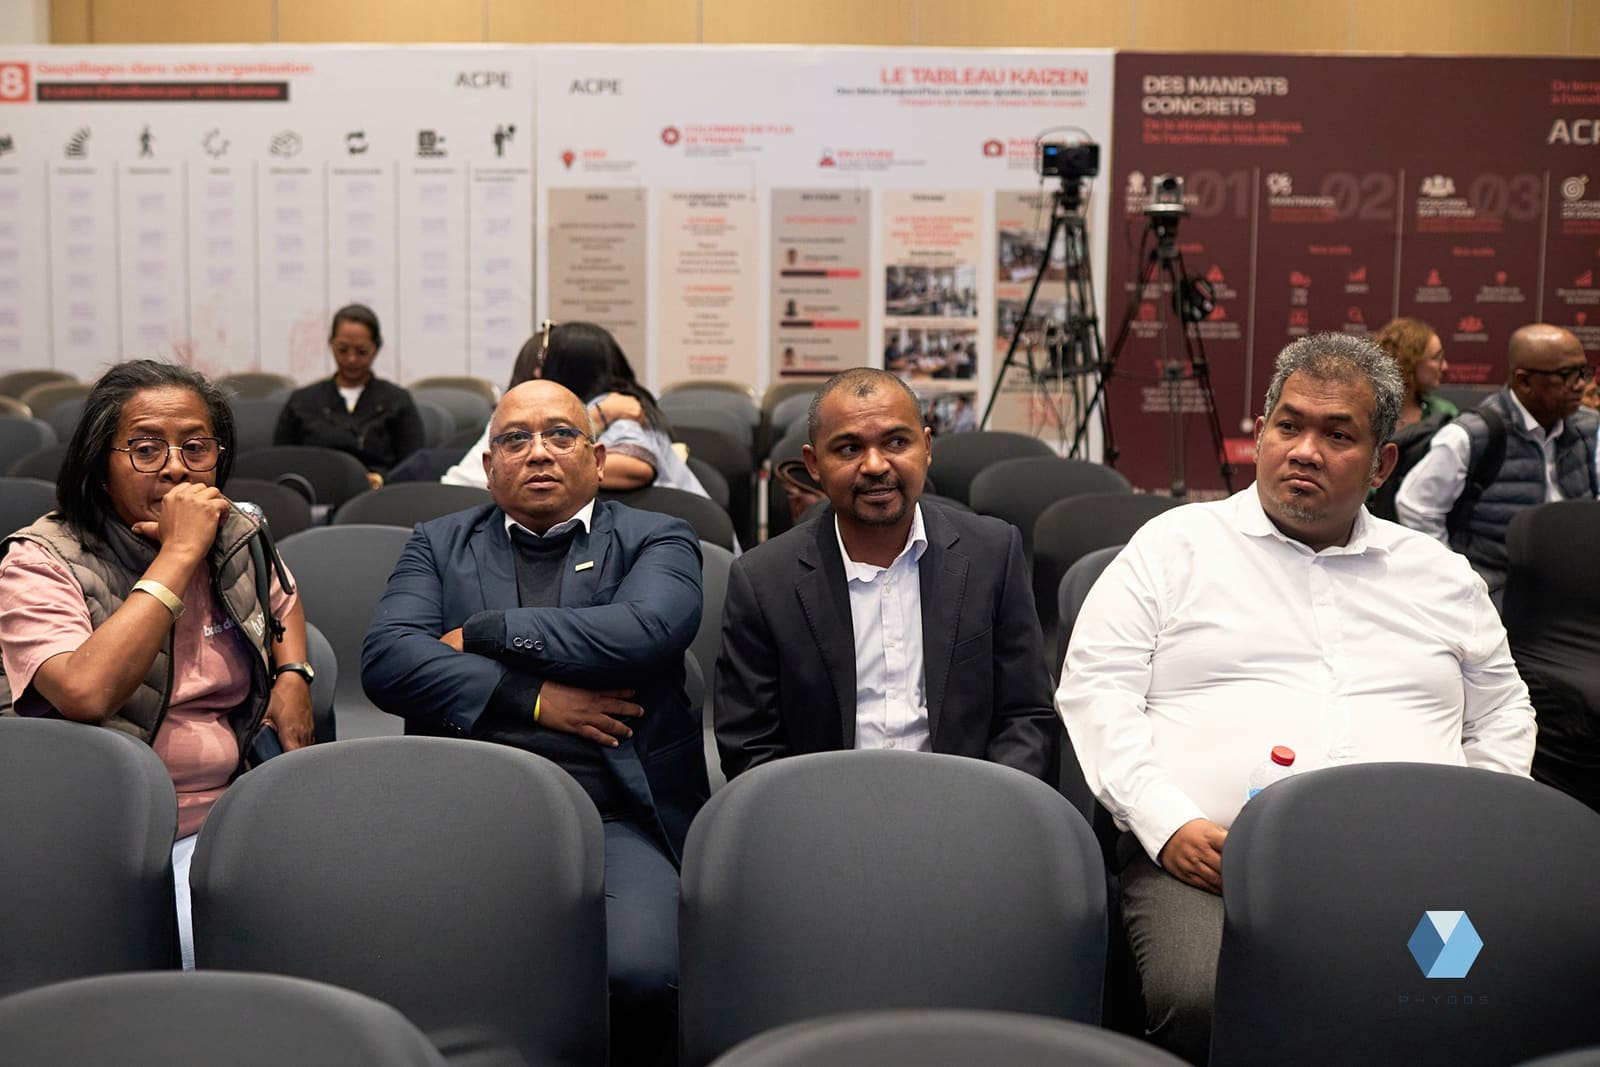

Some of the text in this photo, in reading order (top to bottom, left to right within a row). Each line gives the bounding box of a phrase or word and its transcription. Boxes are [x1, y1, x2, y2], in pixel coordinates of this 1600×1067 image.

[0, 65, 25, 100] 8
[455, 71, 511, 89] ACPE
[880, 67, 1088, 86] LE TABLEAU KAIZEN
[1143, 75, 1289, 96] DES MANDATS
[570, 78, 622, 96] ACPE
[1141, 96, 1256, 116] CONCRETS
[1319, 172, 1396, 220] 02
[1470, 173, 1541, 221] 03
